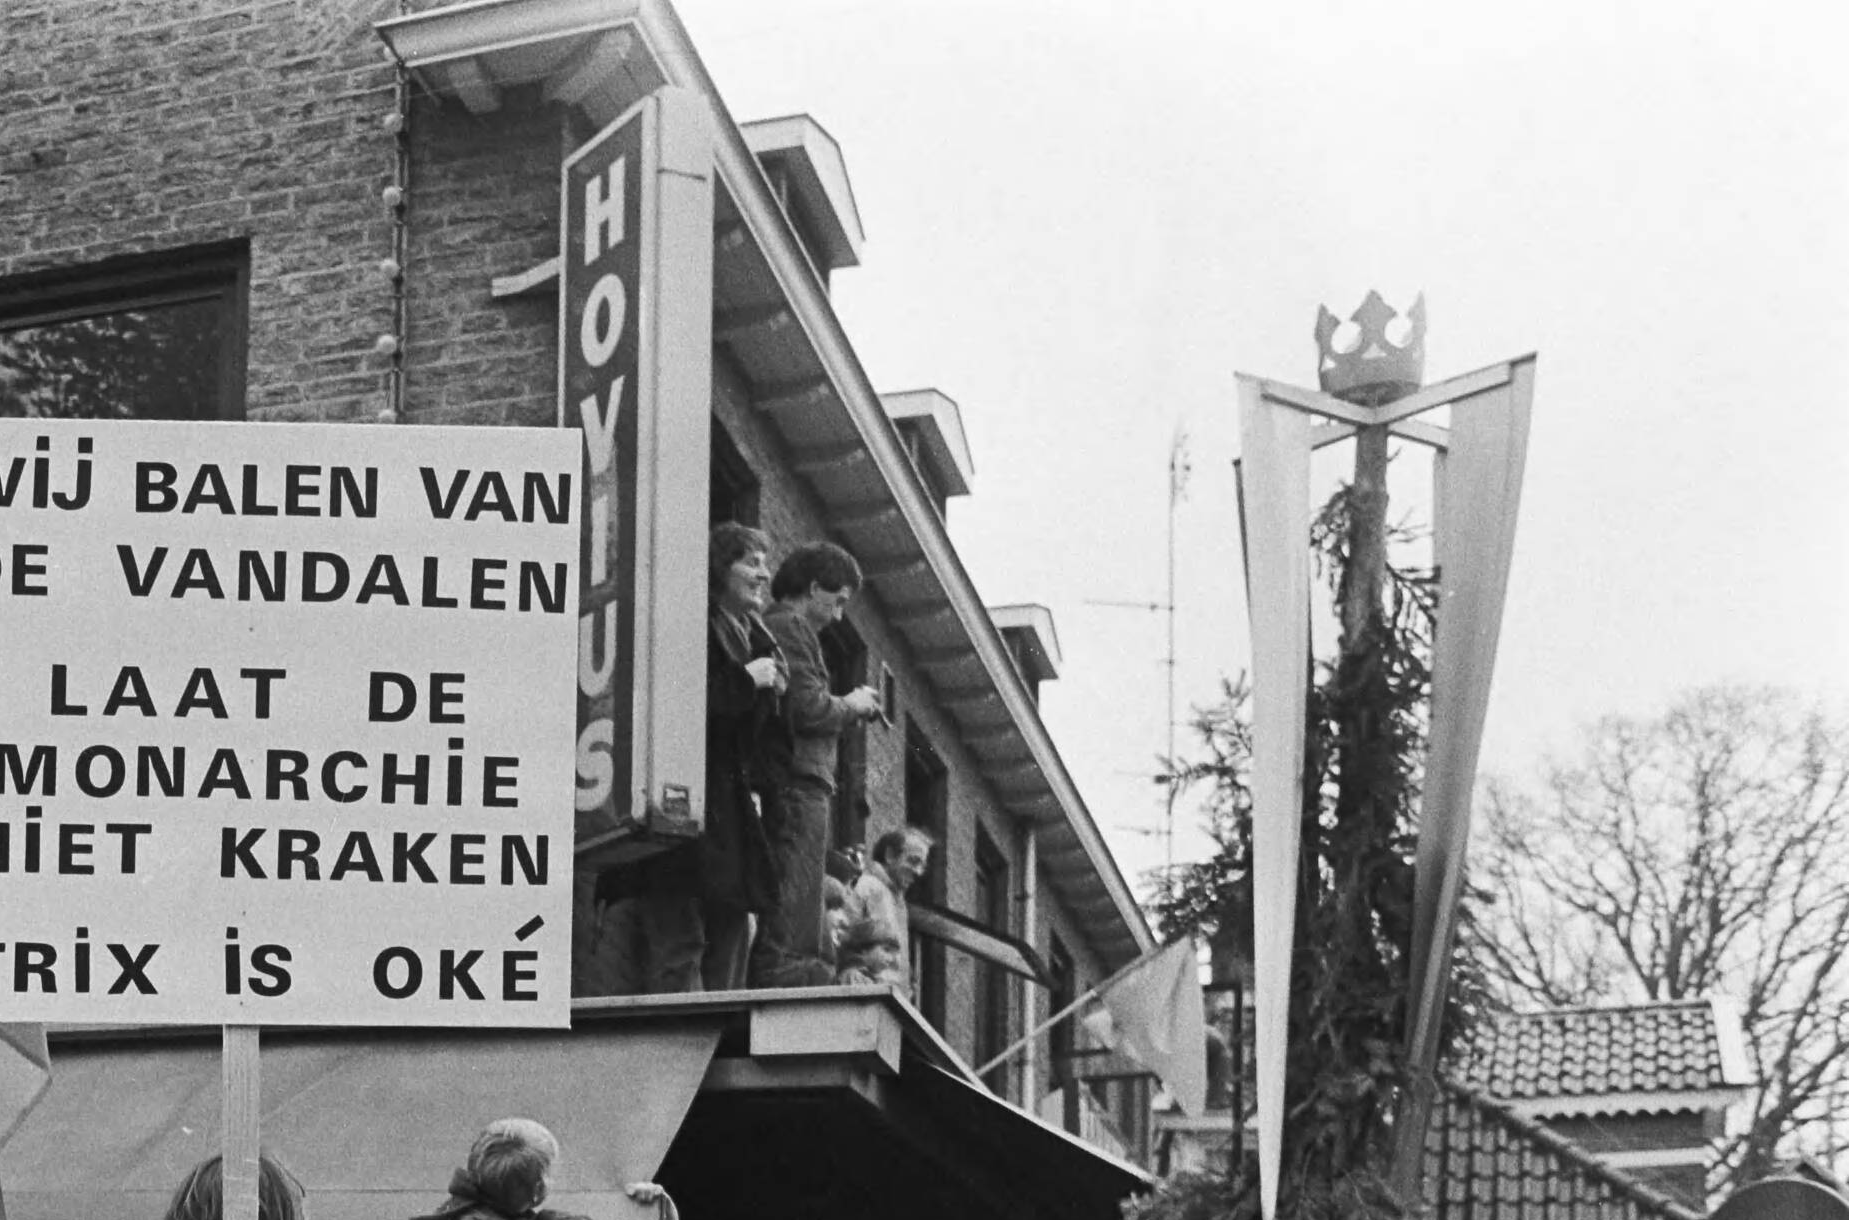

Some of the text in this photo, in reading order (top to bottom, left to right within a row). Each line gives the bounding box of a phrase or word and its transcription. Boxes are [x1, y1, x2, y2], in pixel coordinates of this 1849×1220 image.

[135, 461, 379, 518] BALEN
[418, 466, 572, 525] VAN
[574, 154, 627, 812] HOVIUS
[116, 544, 568, 614] VANDALEN
[50, 663, 466, 724] LAAT DE
[220, 827, 549, 886] KRAKEN
[372, 914, 545, 1002] OKÉ
